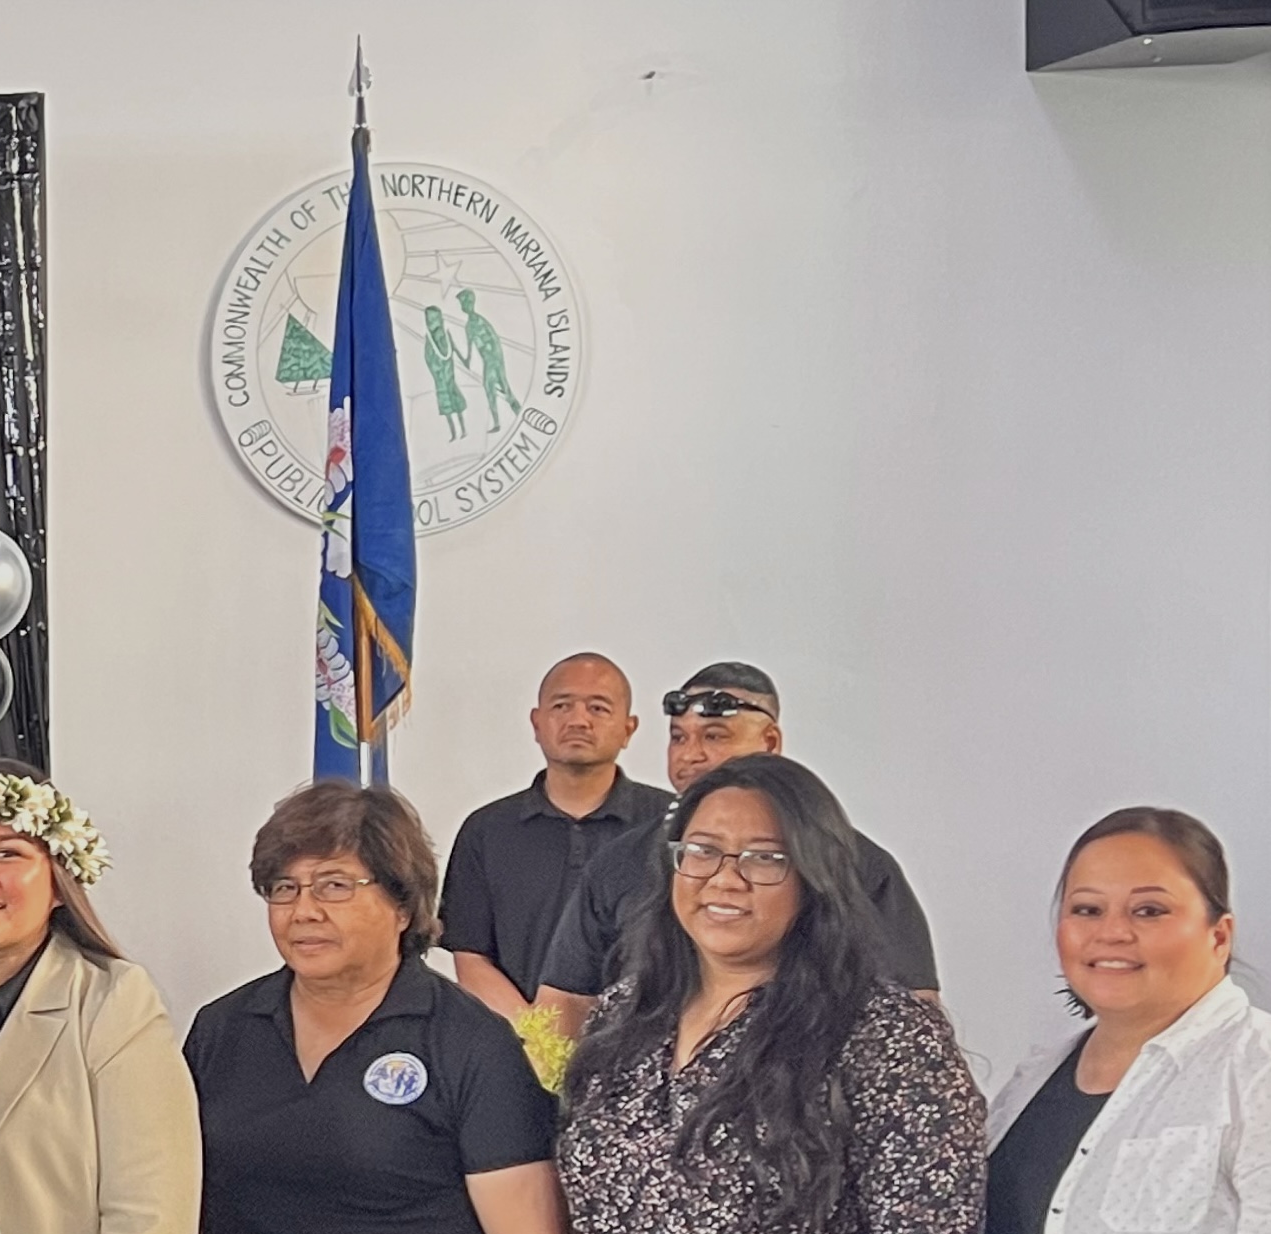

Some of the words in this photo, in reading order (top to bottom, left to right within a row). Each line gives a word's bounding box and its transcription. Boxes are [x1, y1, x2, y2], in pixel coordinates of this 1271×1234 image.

[221, 227, 292, 408] COMMONWEALTH
[289, 199, 318, 231] OF
[321, 182, 350, 211] TH
[380, 173, 500, 224] NORTHERN
[500, 216, 562, 302] MARIANA
[543, 308, 571, 399] ISLANDS
[454, 431, 541, 513] SYSTEM
